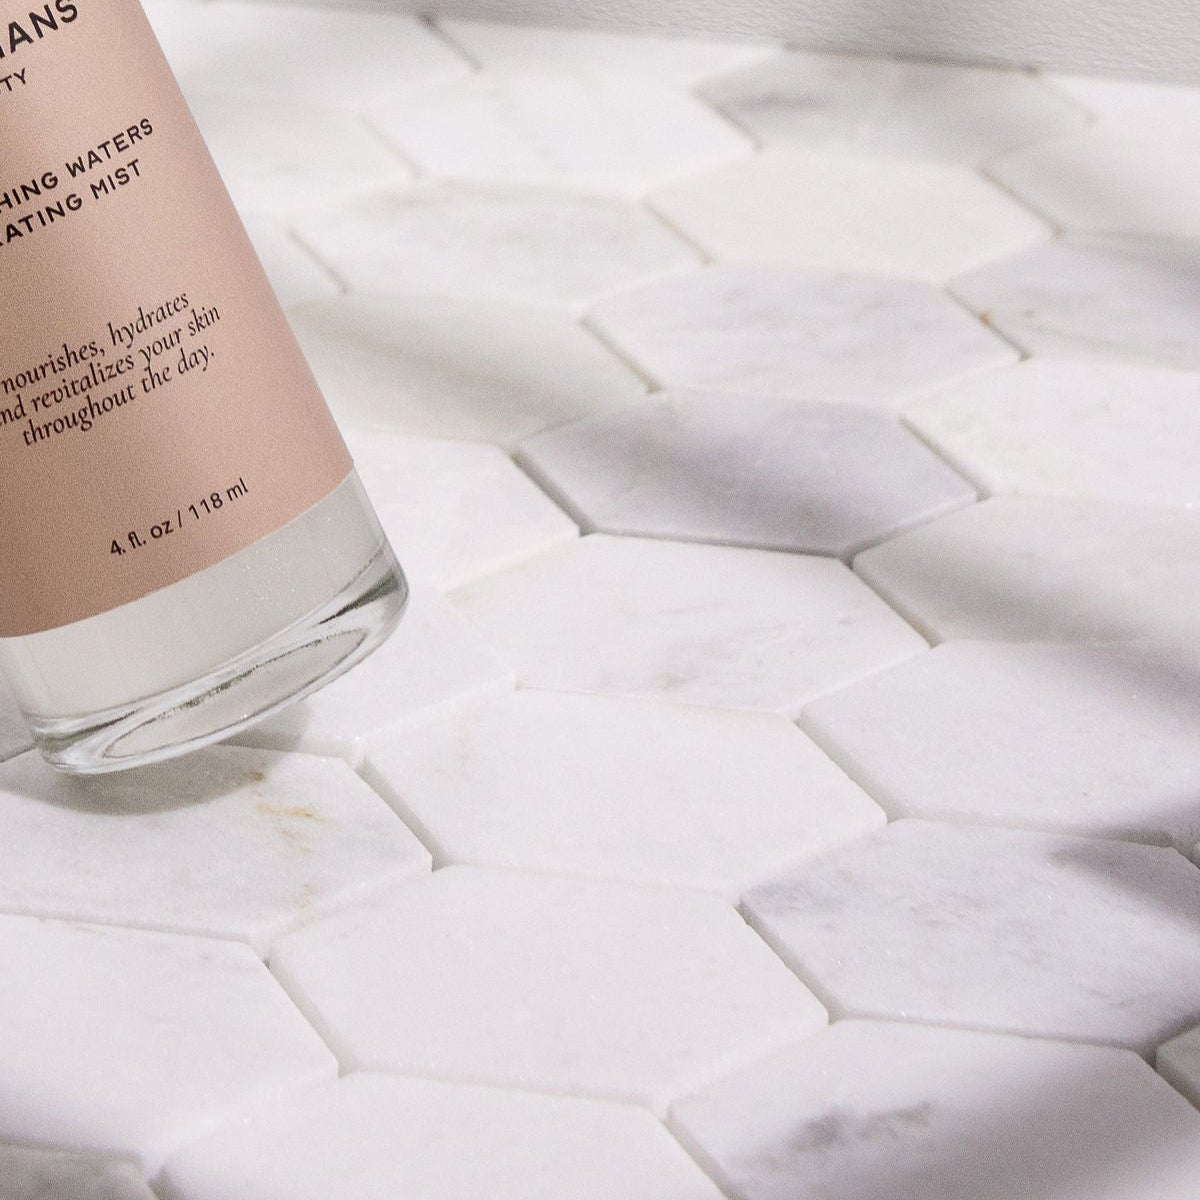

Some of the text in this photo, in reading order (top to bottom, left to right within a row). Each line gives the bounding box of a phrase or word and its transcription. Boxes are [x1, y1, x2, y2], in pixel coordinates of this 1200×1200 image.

[64, 118, 154, 179] WATERS
[89, 158, 141, 200] MIST
[0, 292, 189, 395] nourishes, hydrates
[30, 353, 135, 413] revitalizes
[137, 328, 182, 367] your
[187, 305, 221, 337] skin
[22, 345, 216, 447] throughout the day.
[110, 476, 249, 556] 4. fl. oz / 118 ml
